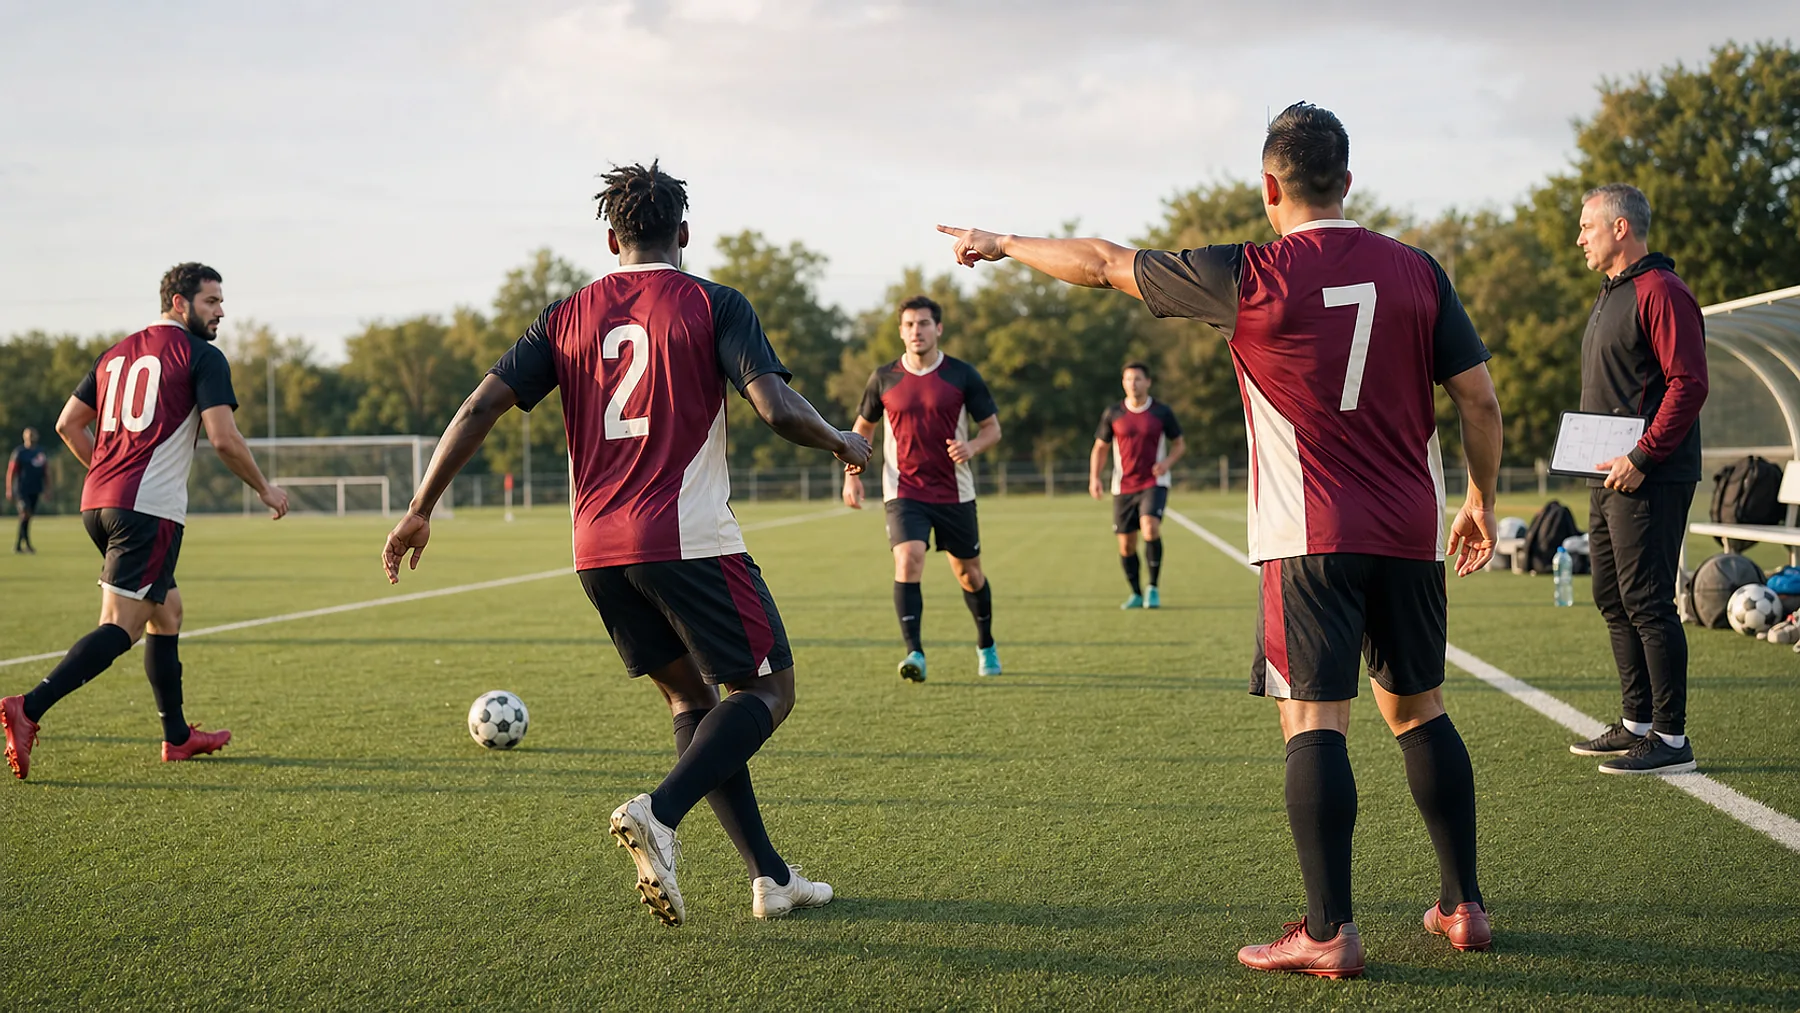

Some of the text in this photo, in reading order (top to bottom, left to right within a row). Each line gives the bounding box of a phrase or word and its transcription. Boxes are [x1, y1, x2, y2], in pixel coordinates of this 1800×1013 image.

[102, 355, 162, 433] 10
[603, 324, 649, 440] 2
[1322, 282, 1377, 411] 7
